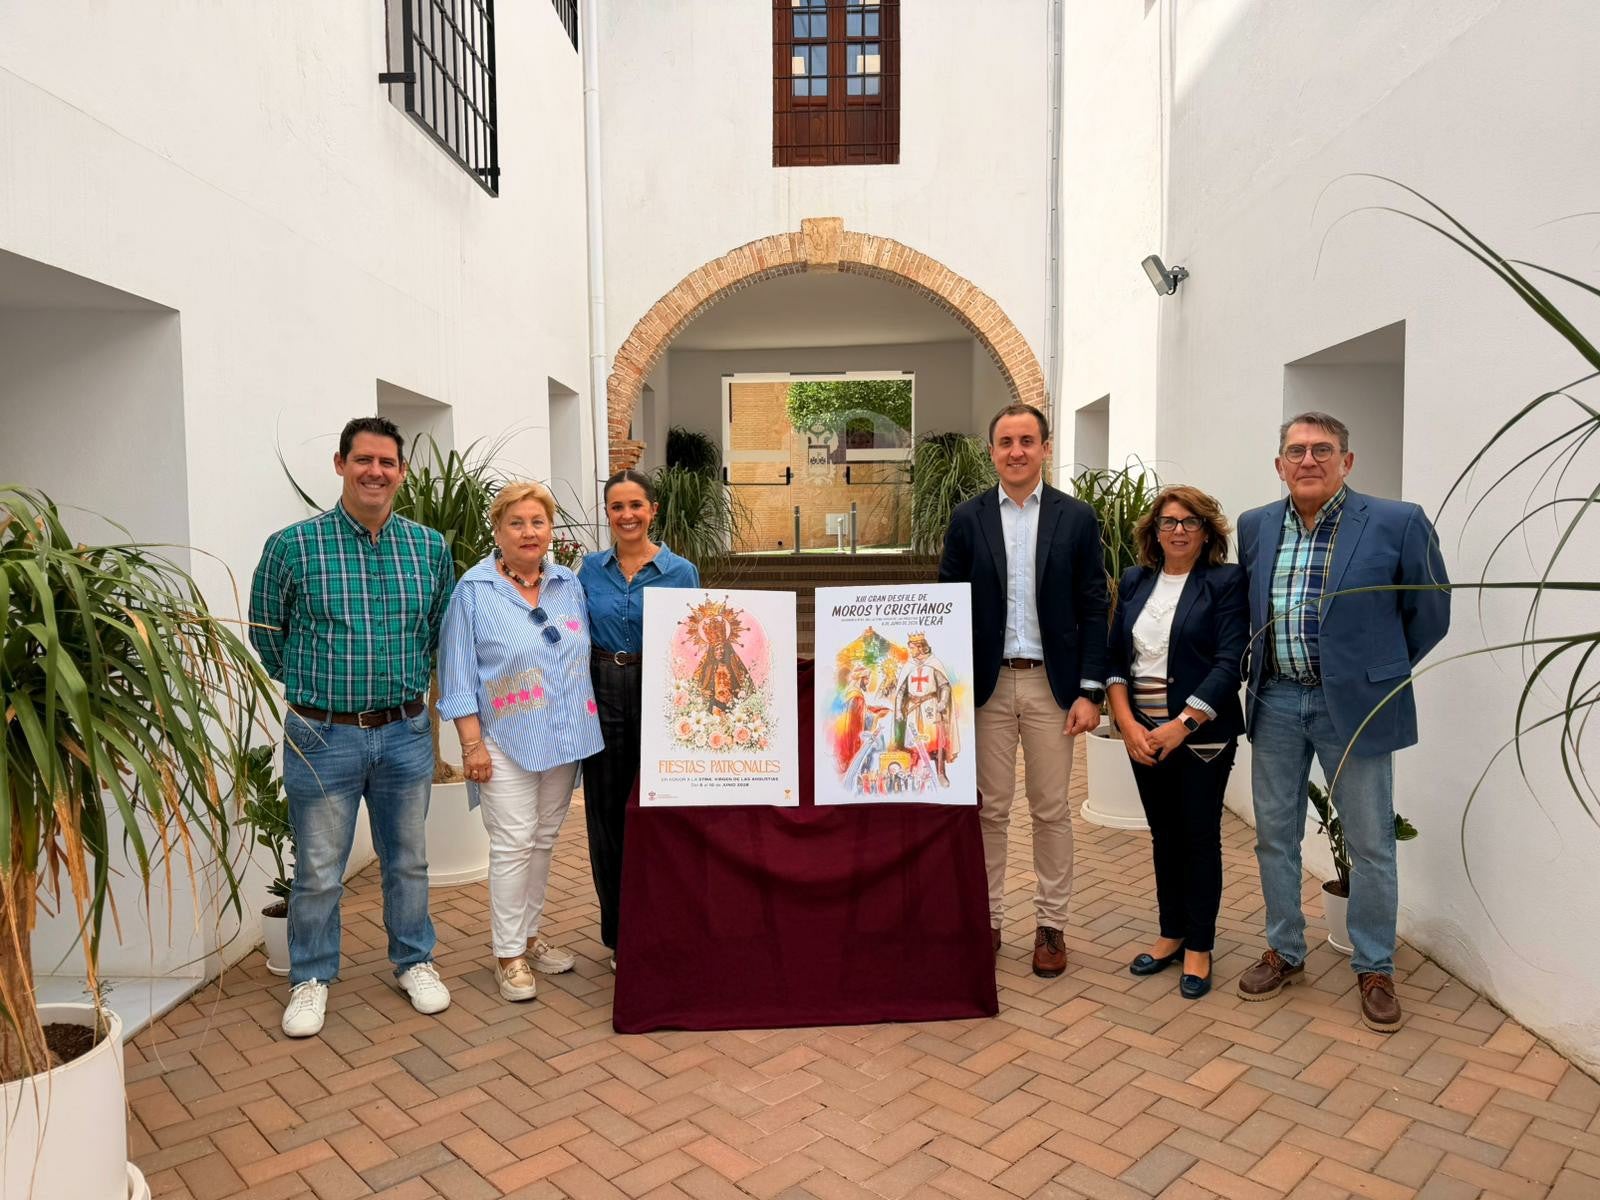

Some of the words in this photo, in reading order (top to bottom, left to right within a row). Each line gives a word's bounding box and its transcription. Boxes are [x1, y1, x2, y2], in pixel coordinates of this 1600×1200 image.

[887, 594, 915, 602] DESFILE
[917, 593, 928, 601] DE
[832, 604, 872, 617] MOROS
[875, 604, 883, 615] Y
[884, 602, 953, 616] CRISTIANOS
[918, 616, 944, 626] VERA
[658, 759, 705, 773] FIESTAS
[710, 759, 781, 775] PATRONALES
